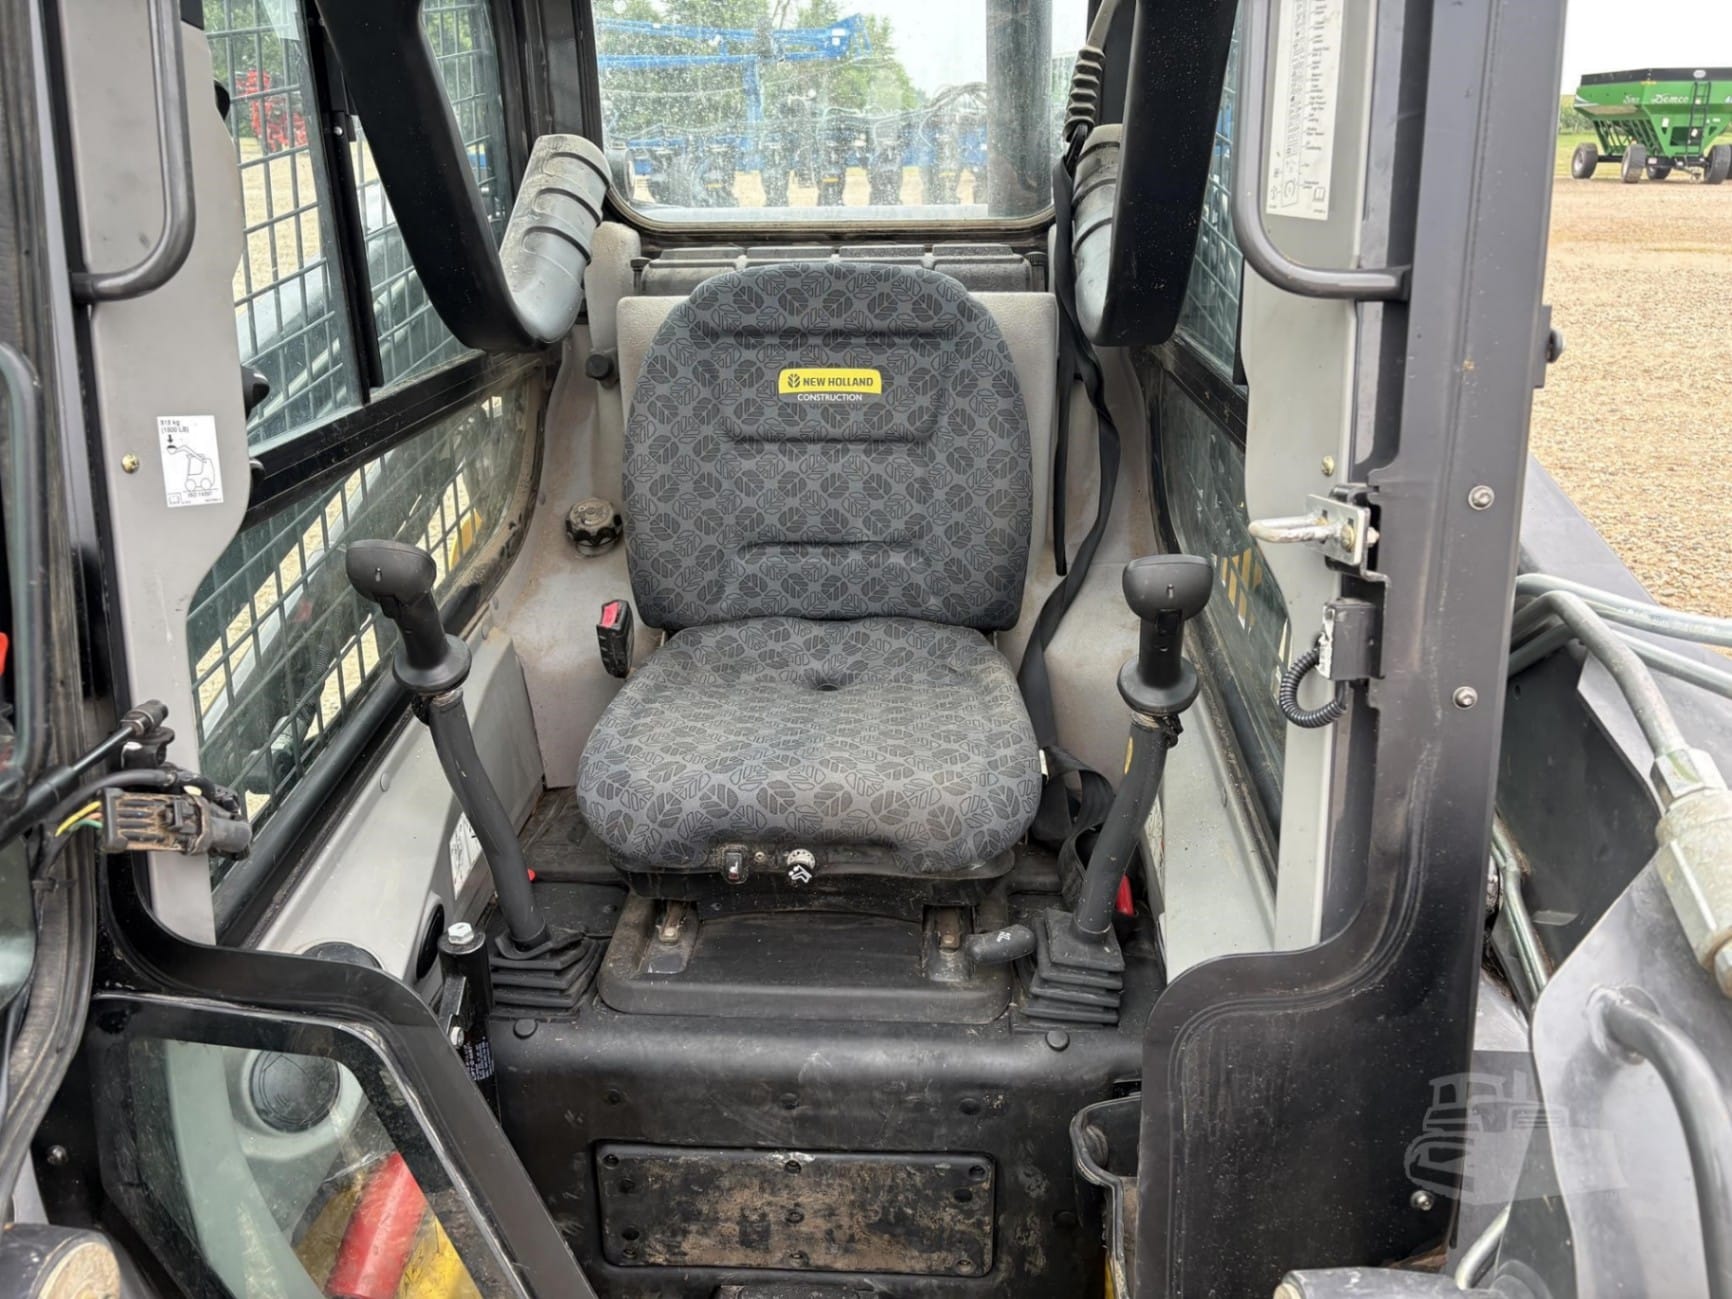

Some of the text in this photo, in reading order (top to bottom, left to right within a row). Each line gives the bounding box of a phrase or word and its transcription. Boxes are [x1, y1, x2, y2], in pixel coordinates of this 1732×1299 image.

[803, 377, 874, 387] NEW HOLLAND
[797, 393, 863, 401] CONSTRUCTION
